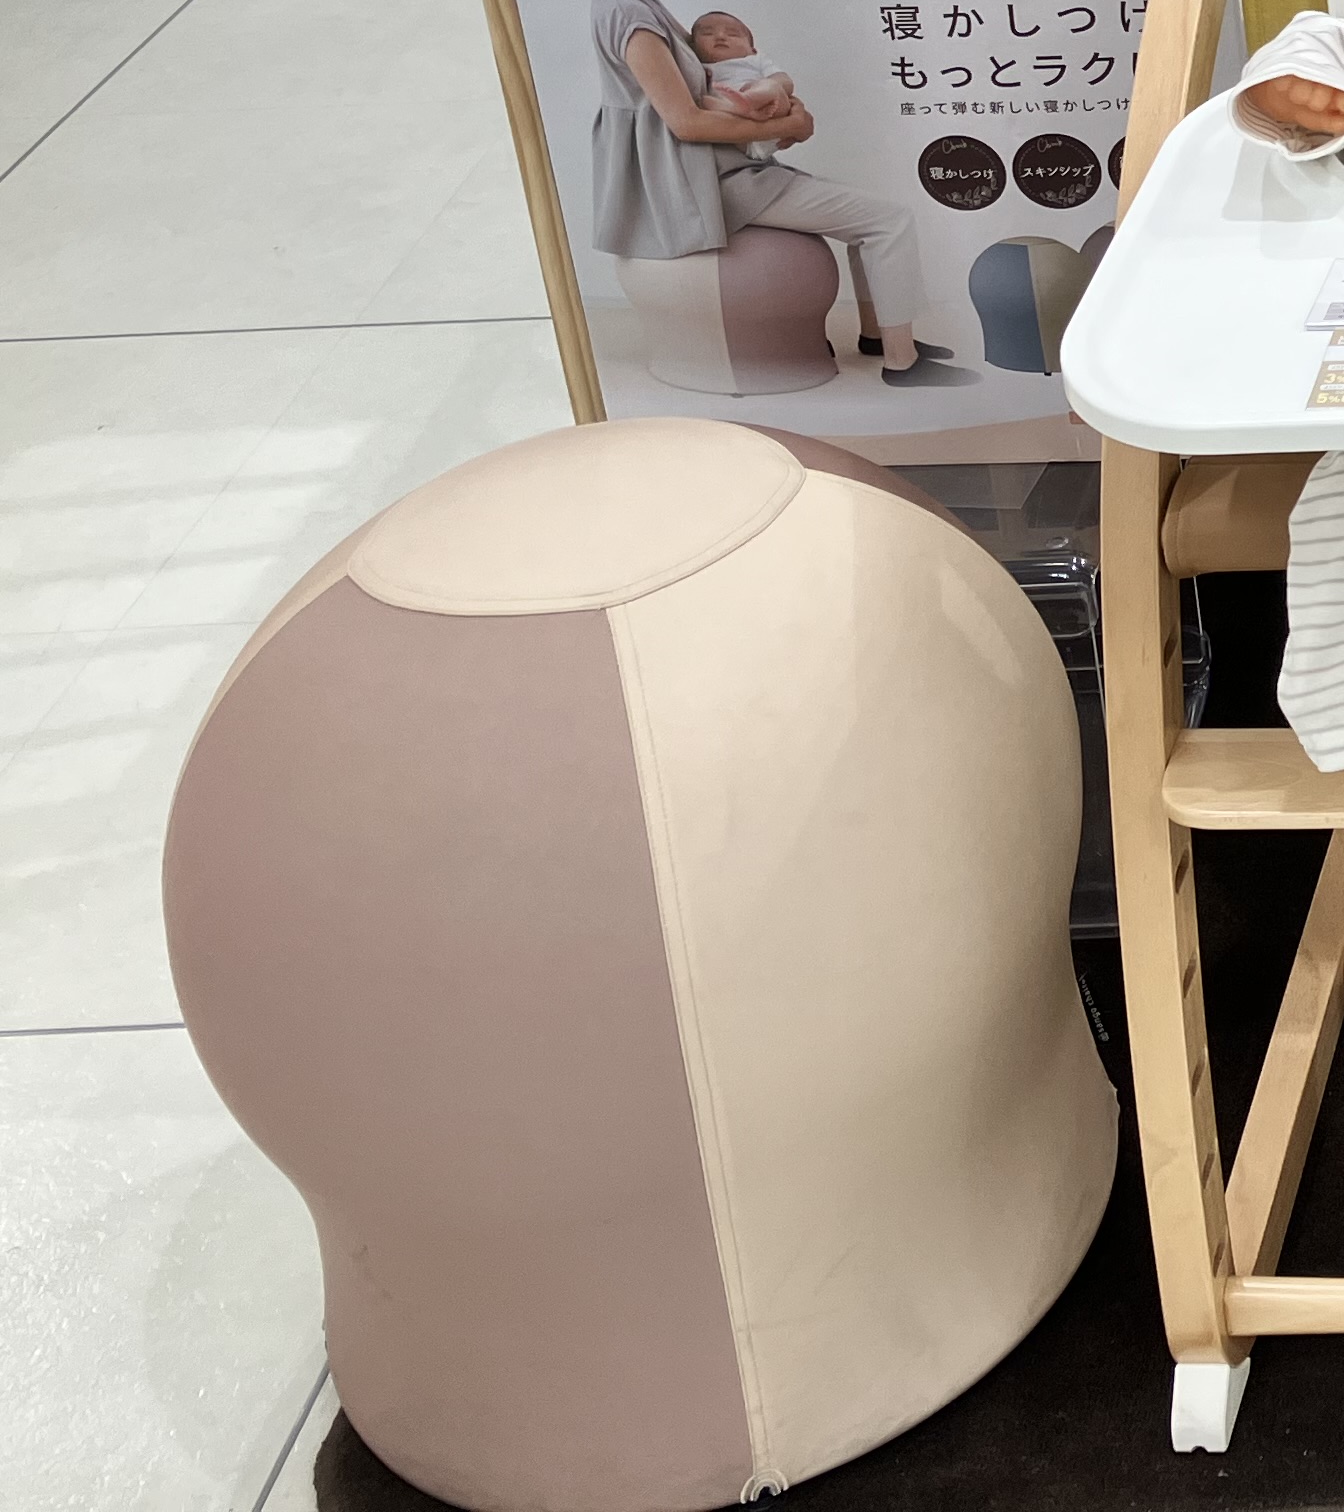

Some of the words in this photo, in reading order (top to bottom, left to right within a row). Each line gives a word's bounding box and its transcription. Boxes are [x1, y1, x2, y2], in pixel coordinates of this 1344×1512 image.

[890, 52, 1137, 90] もっとラク
[900, 97, 1131, 116] 座って弾む新しい寝かしつけ
[929, 166, 995, 180] 寝かしつけ
[1020, 164, 1096, 179] スキンシップ
